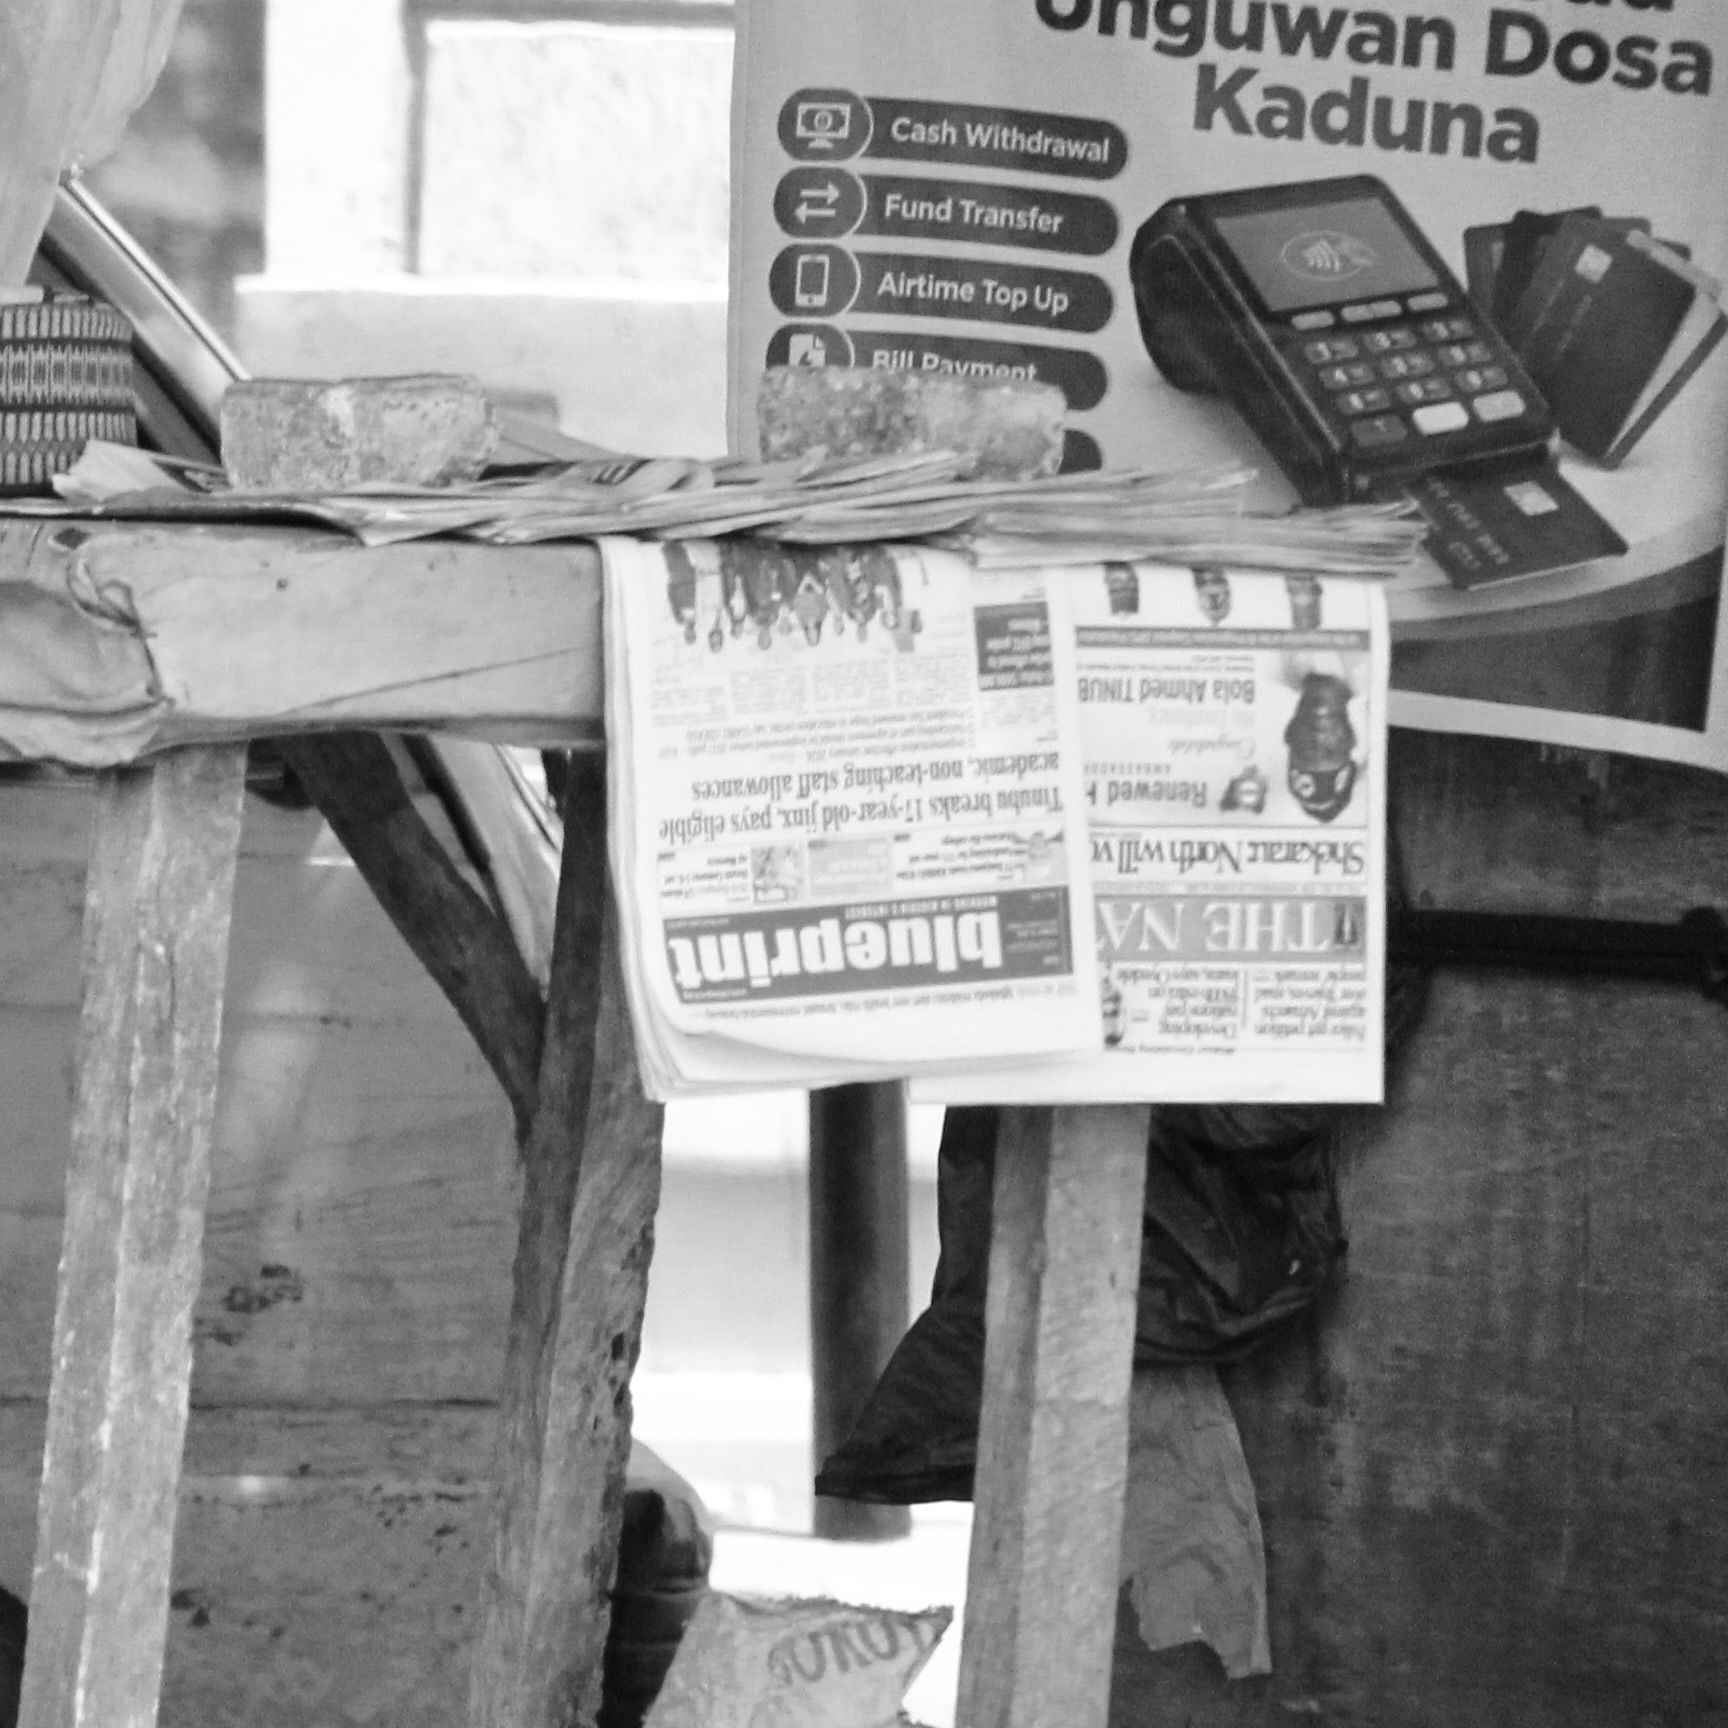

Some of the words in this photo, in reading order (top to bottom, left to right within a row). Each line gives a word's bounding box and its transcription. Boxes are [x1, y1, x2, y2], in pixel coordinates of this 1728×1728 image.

[1485, 7, 1712, 97] Dosa
[1192, 62, 1539, 164] Kaduna
[890, 116, 959, 145] Cash
[964, 121, 1110, 163] Withdrawal
[884, 193, 953, 222] Fund
[959, 199, 1064, 233] Transfer
[876, 270, 976, 303] Airtime
[981, 278, 1028, 313] Top
[1033, 284, 1070, 317] Up
[871, 349, 915, 372] Bill
[1139, 679, 1205, 705] Ahmed
[1212, 679, 1255, 704] Bola
[844, 761, 965, 794] non-teaching
[967, 752, 1059, 783] academic,
[690, 774, 794, 802] allowances
[796, 771, 839, 799] staff
[996, 786, 1065, 817] Tinubu
[1107, 781, 1207, 809] Renewed
[730, 804, 773, 832] pays
[822, 792, 924, 834] 17-year-old
[928, 793, 993, 823] breaks
[658, 809, 726, 845] eligible
[1117, 840, 1164, 874] will
[1170, 840, 1243, 875] North
[1094, 902, 1185, 952] NA
[1200, 902, 1329, 953] THE
[667, 911, 1003, 990] blueprint
